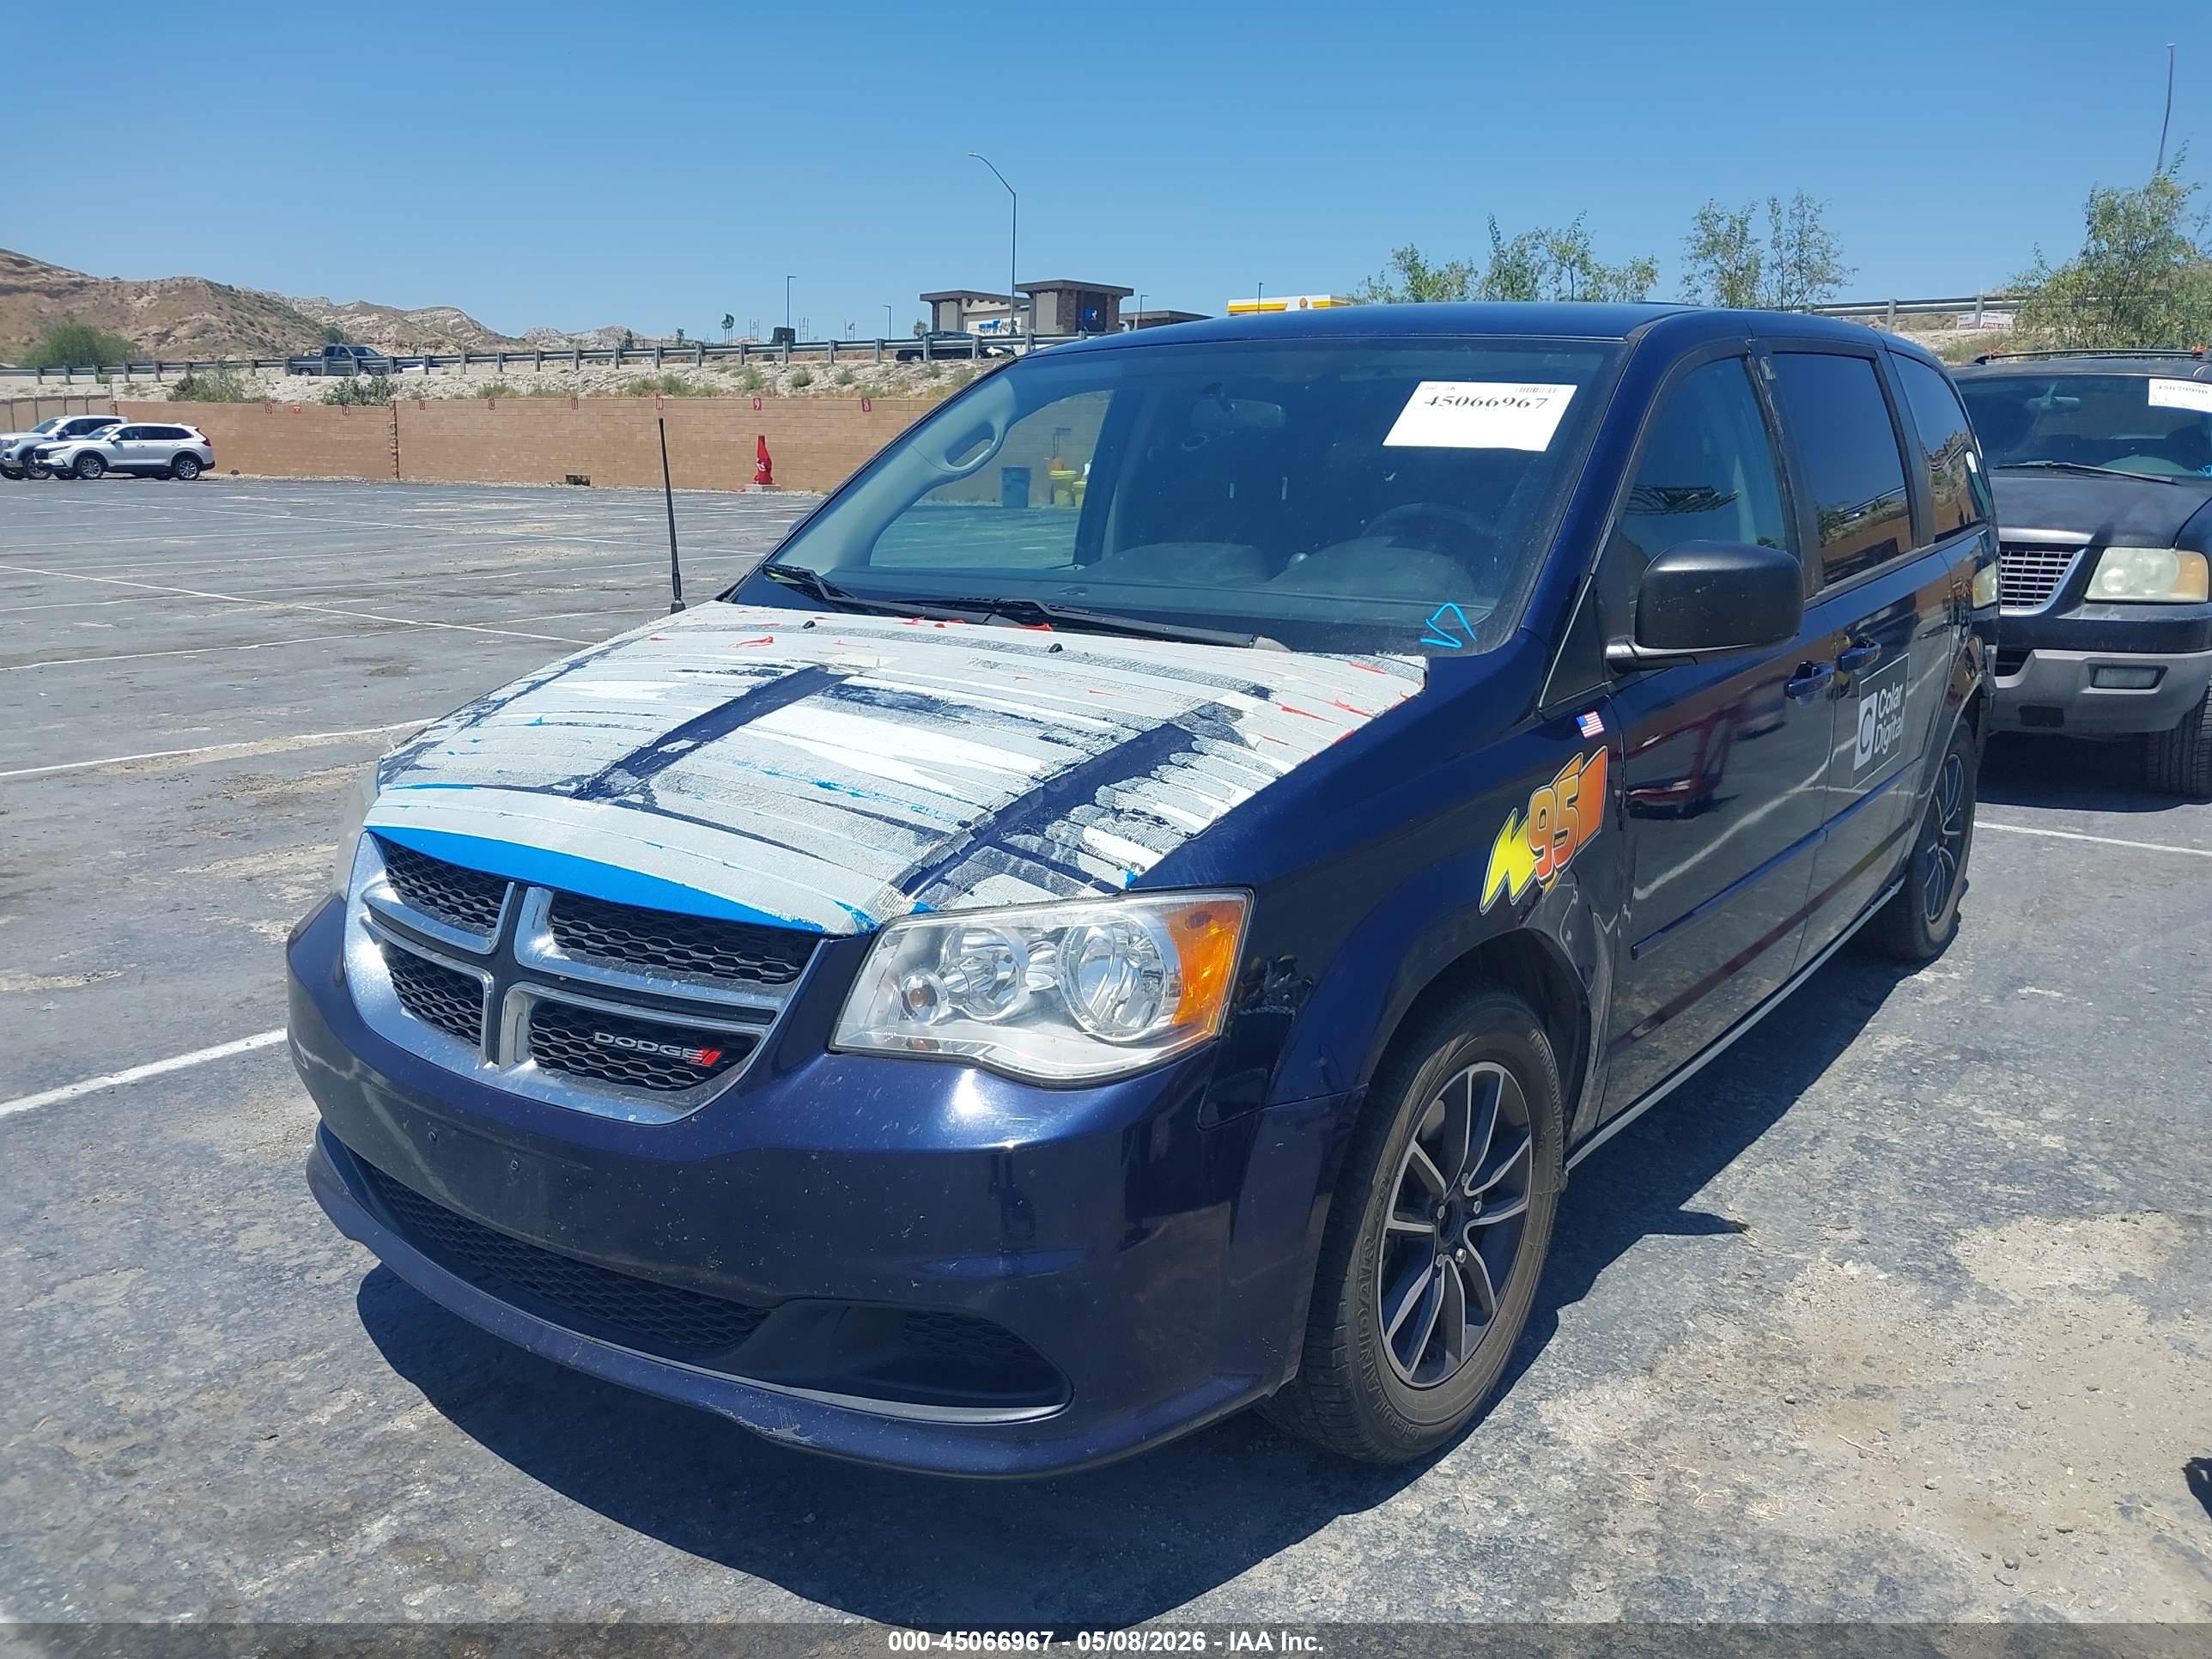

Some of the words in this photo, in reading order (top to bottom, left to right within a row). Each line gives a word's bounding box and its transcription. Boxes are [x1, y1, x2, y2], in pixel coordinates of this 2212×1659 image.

[1424, 395, 1549, 409] 45066967
[1878, 682, 1903, 719] Colar
[1874, 714, 1904, 755] Digital
[1528, 774, 1580, 885] 95
[594, 1031, 702, 1060] DODGE
